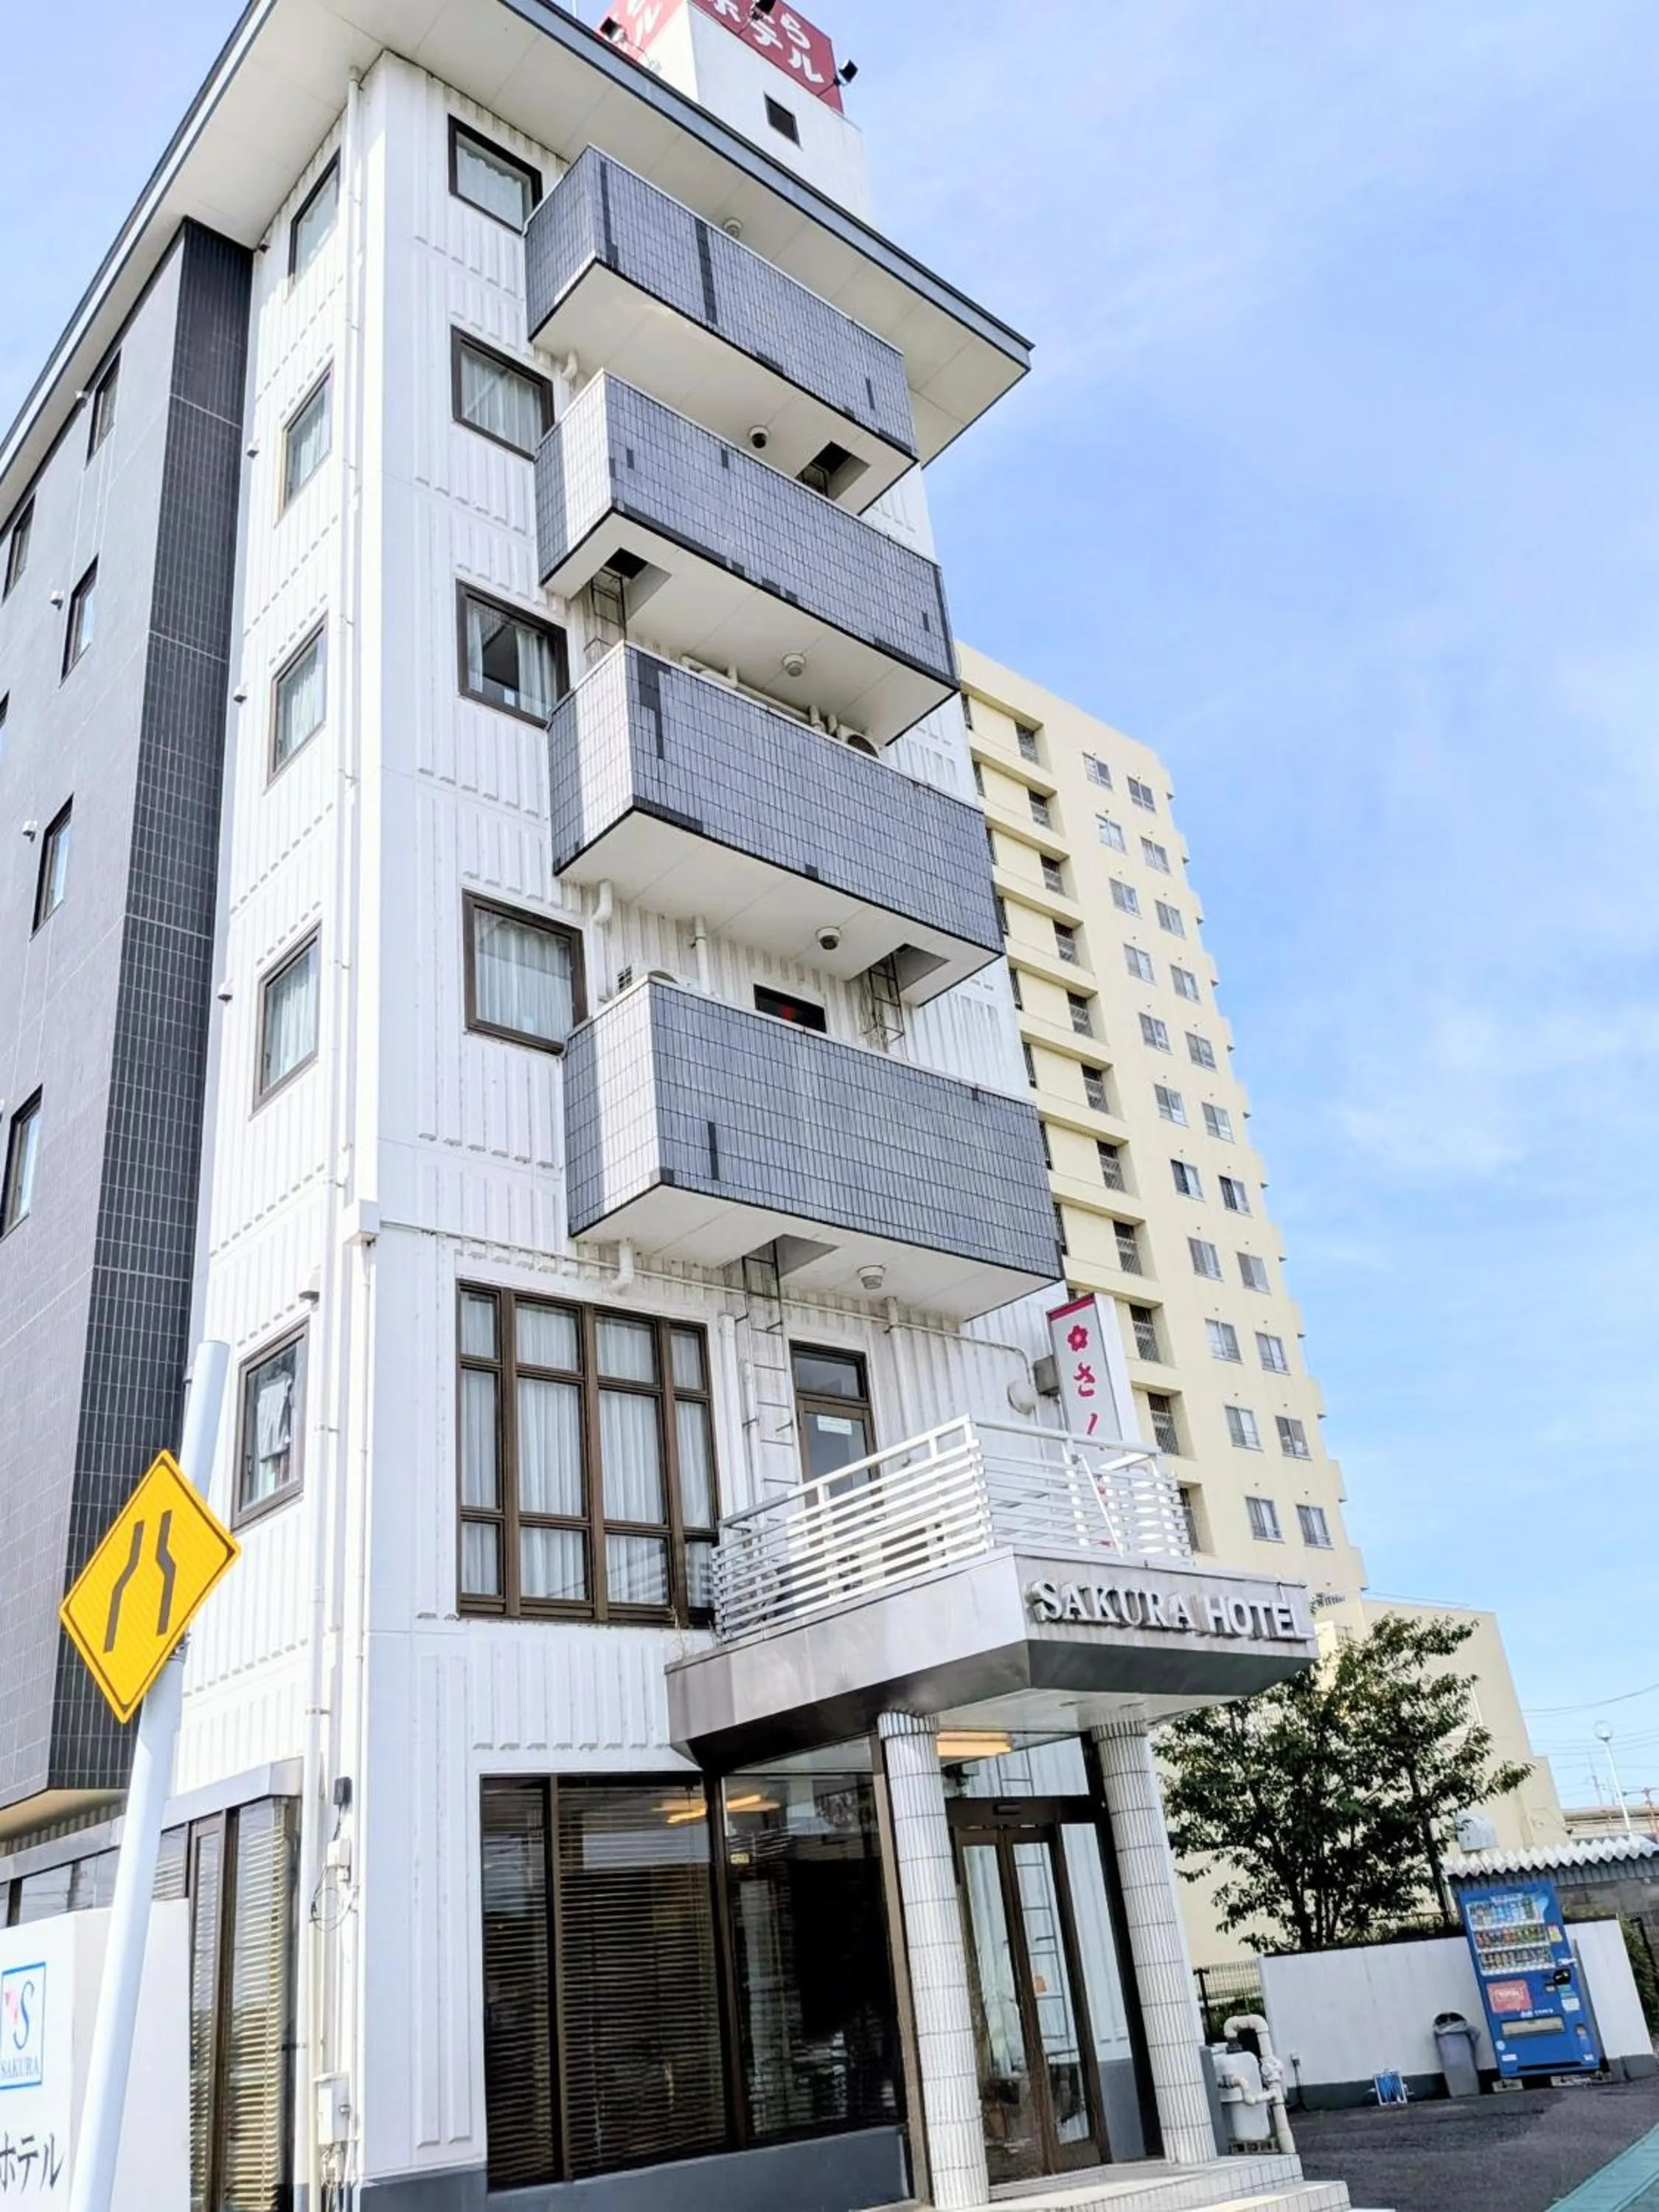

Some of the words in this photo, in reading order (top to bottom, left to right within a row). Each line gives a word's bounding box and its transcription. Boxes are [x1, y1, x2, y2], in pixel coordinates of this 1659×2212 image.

[1026, 1580, 1196, 1629] SAKURA
[1203, 1595, 1315, 1639] HOTEL
[0, 2130, 65, 2194] ホテル
